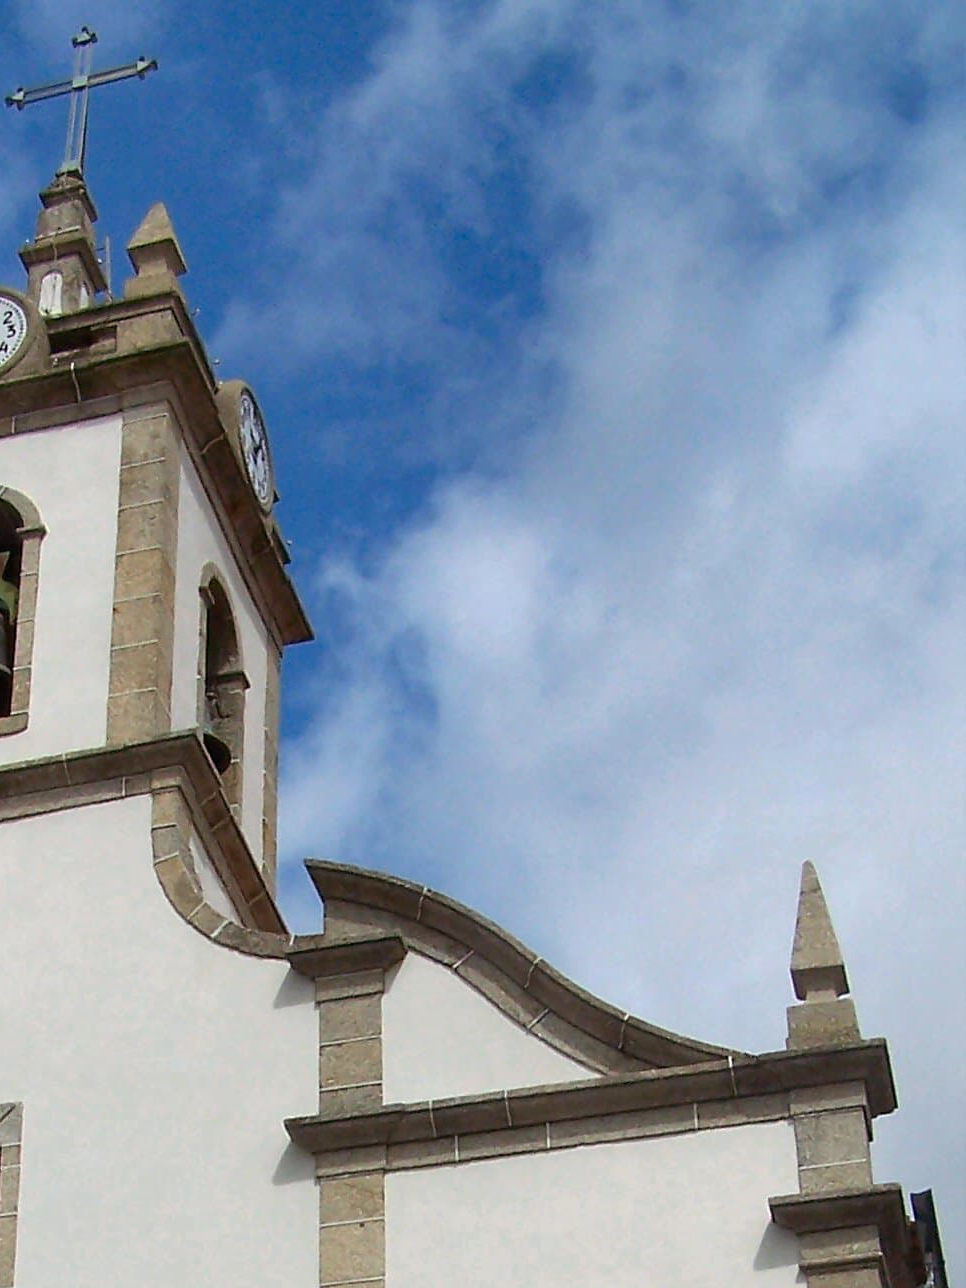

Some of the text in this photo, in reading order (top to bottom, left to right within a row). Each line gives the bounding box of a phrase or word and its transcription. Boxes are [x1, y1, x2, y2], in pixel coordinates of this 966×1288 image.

[3, 311, 13, 325] 2
[7, 325, 16, 338] 3
[0, 342, 8, 354] 4
